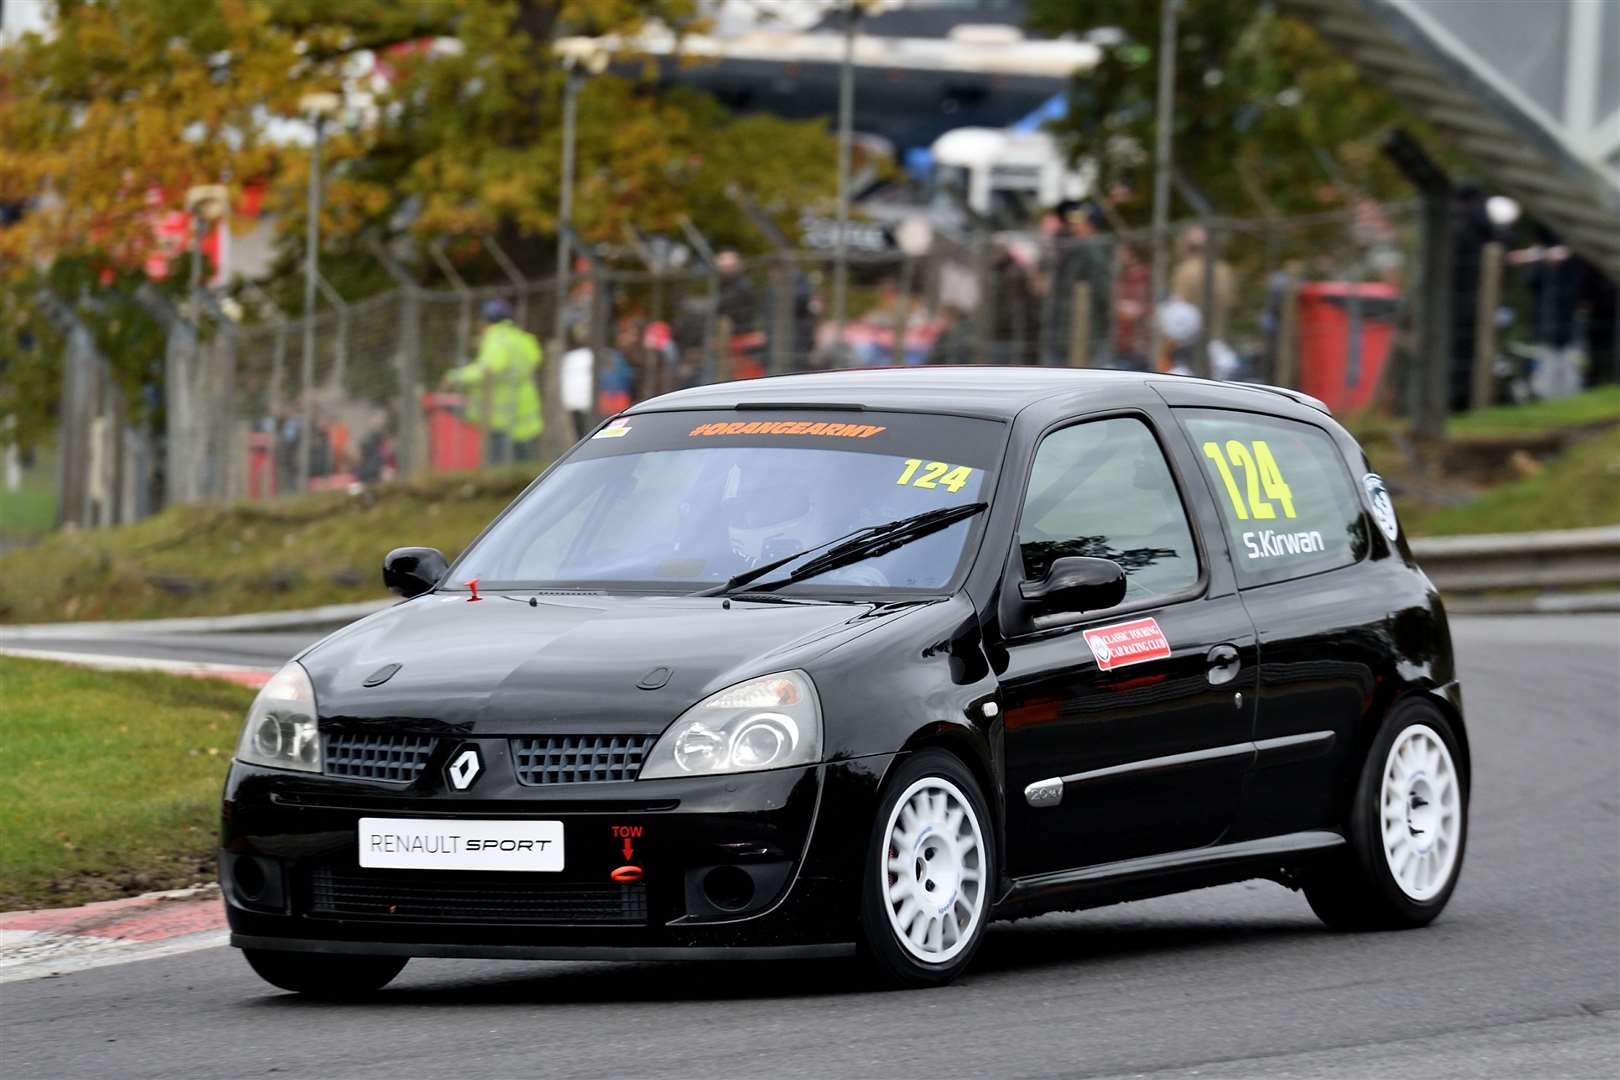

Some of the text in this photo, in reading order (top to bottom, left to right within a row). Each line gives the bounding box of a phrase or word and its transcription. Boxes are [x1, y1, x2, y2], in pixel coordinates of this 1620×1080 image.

[688, 422, 886, 438] #ORANGEARMY
[896, 458, 972, 493] 124
[1203, 440, 1296, 520] 124
[1243, 530, 1325, 559] S.Kirwan
[370, 834, 552, 854] RENAULT SPORT
[611, 826, 643, 838] TOW
